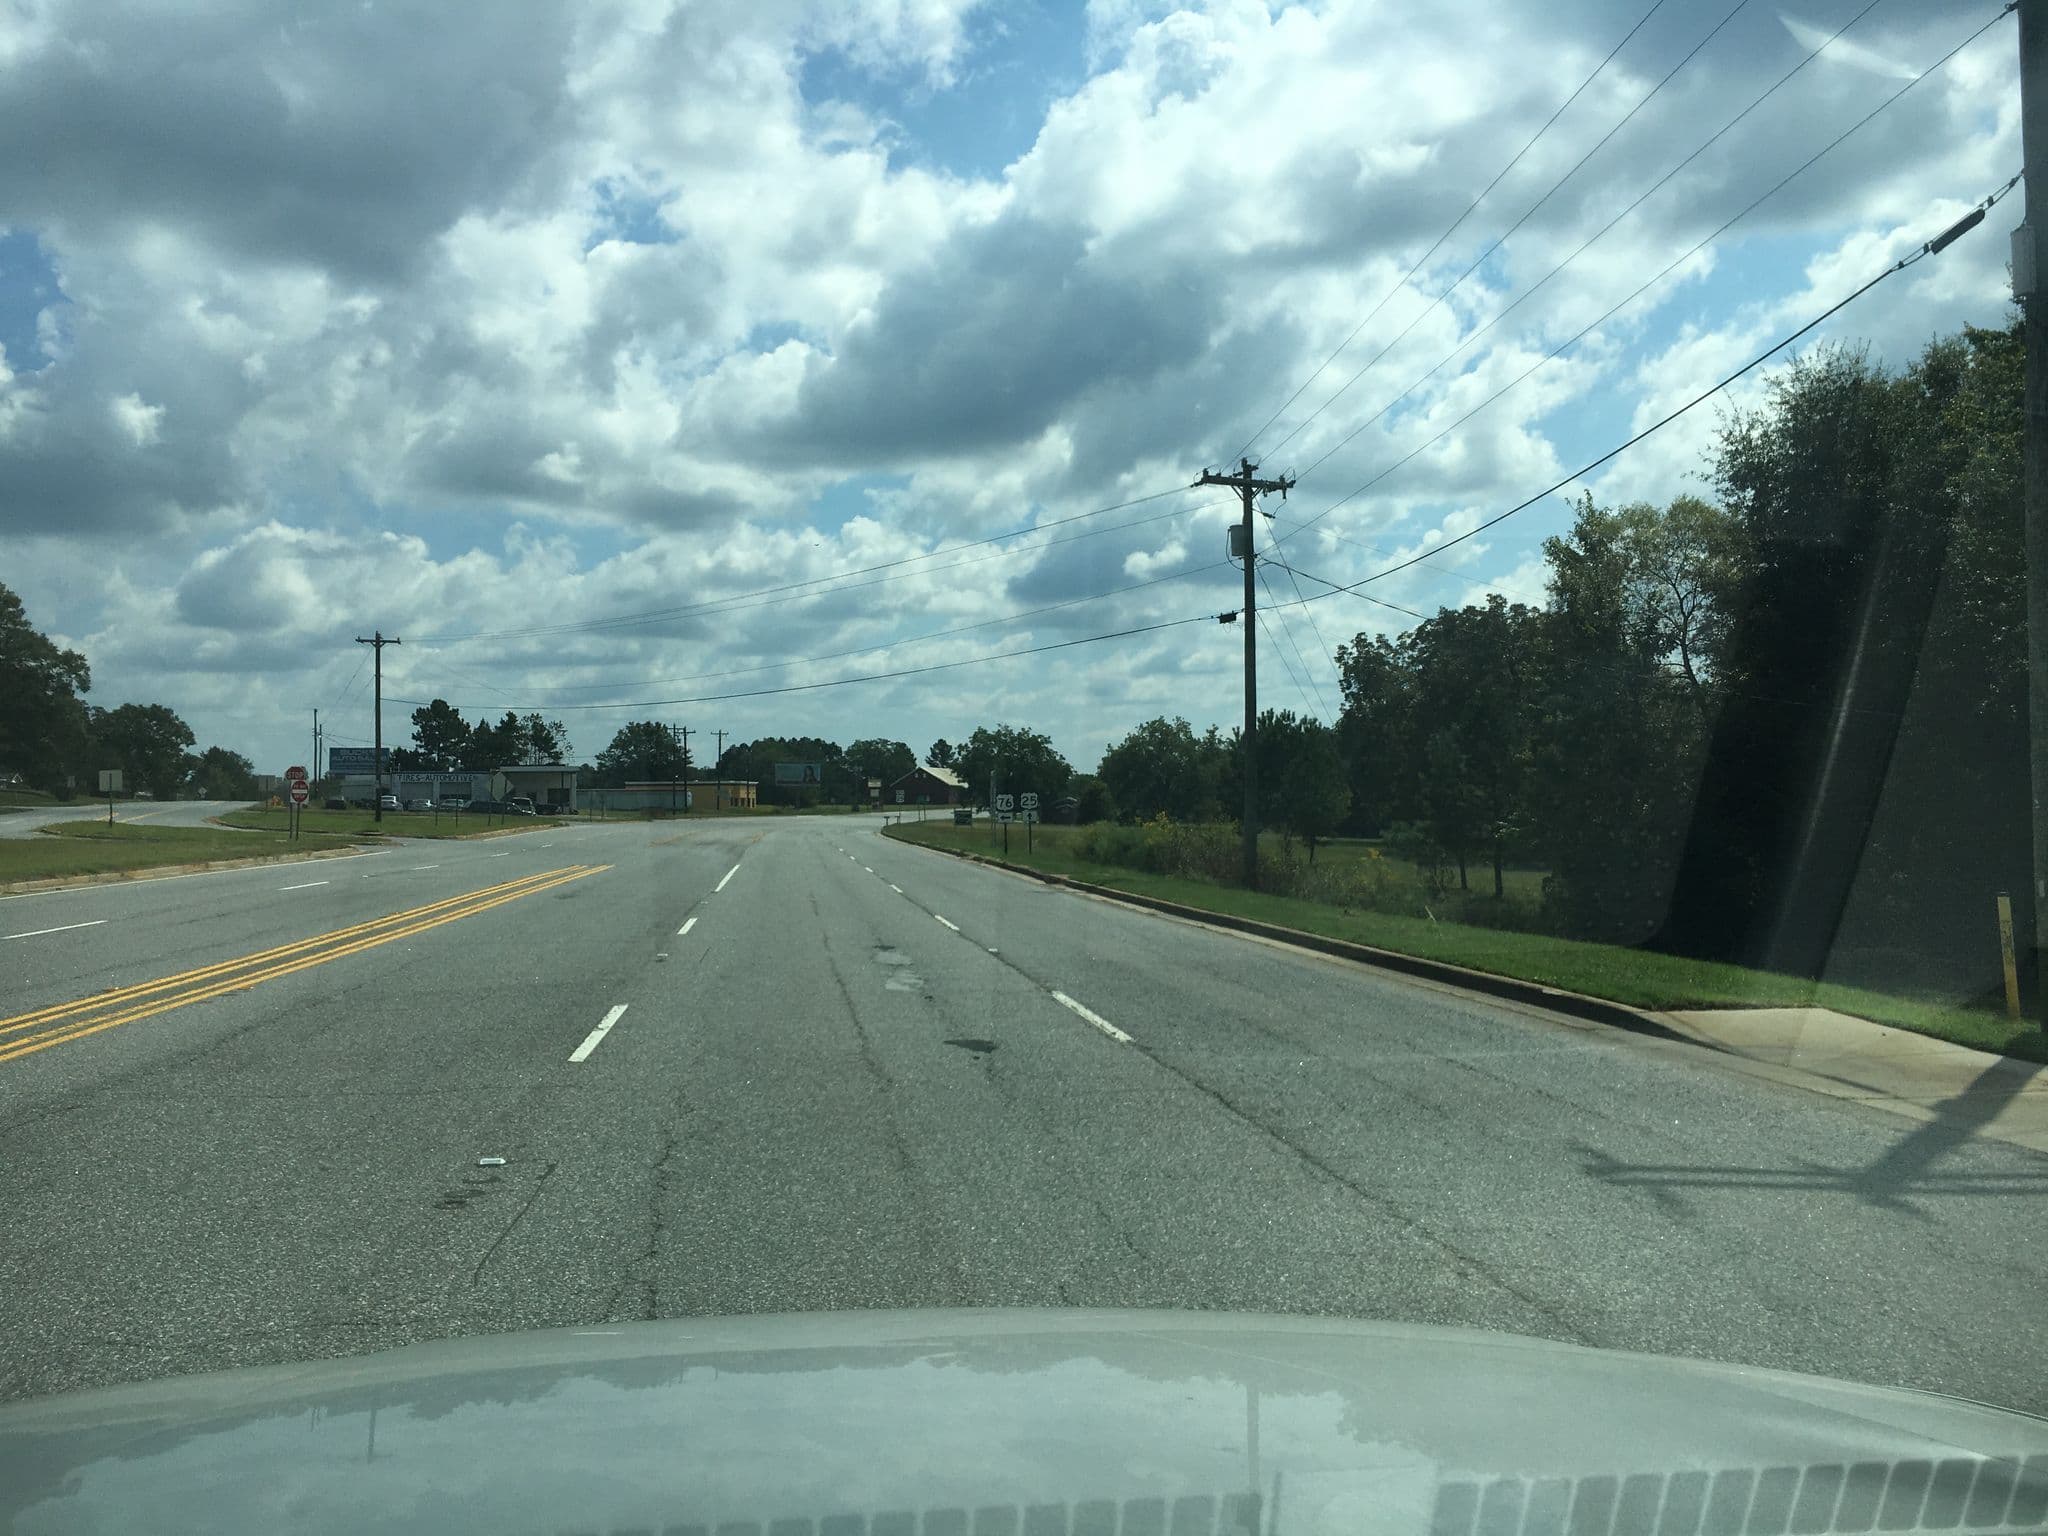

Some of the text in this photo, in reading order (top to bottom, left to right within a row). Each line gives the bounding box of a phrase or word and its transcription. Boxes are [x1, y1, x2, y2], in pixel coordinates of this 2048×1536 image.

[287, 771, 305, 779] STOP
[998, 797, 1012, 808] 76
[1022, 796, 1037, 806] 25
